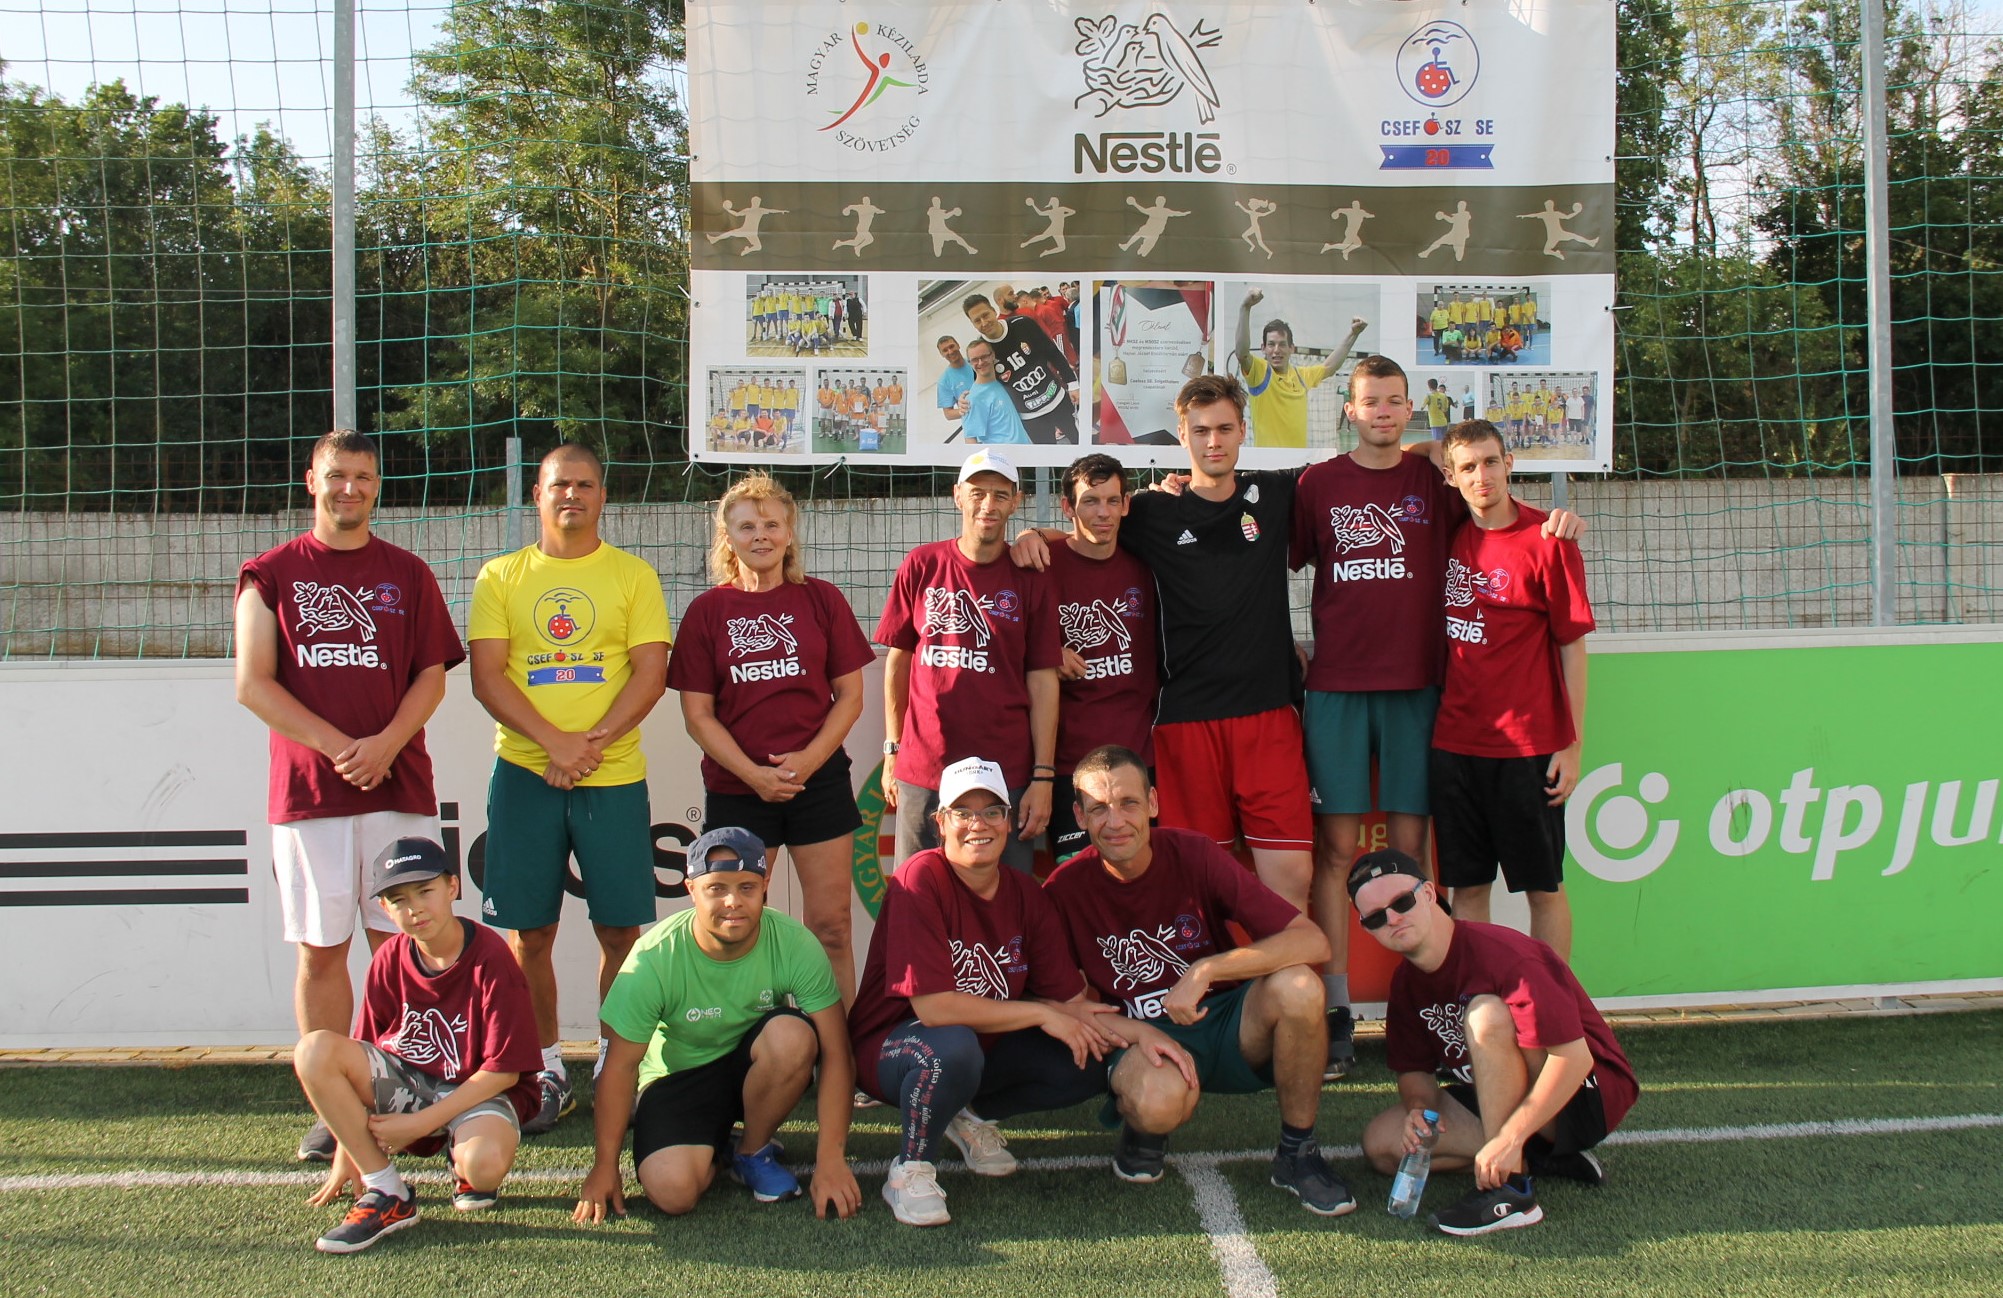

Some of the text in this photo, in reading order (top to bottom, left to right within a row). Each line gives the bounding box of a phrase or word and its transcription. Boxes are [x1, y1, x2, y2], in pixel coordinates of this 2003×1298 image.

[807, 24, 929, 95] MAGYAR KÉZILABDA
[836, 116, 920, 152] SZÖVETSÉG
[1476, 119, 1494, 136] SE
[1074, 132, 1222, 174] Nestlé
[1425, 149, 1450, 166] 20
[1006, 351, 1026, 371] 16
[1333, 557, 1405, 583] Nestlé
[1446, 616, 1485, 644] stlé
[297, 643, 379, 668] Nestlé
[920, 644, 989, 673] Nestlé
[1080, 653, 1132, 680] estlé
[556, 668, 576, 682] 20
[730, 656, 800, 684] Nestlé
[1708, 767, 2003, 881] otp ju
[855, 808, 887, 903] AGYAR
[931, 1057, 942, 1084] enjoy
